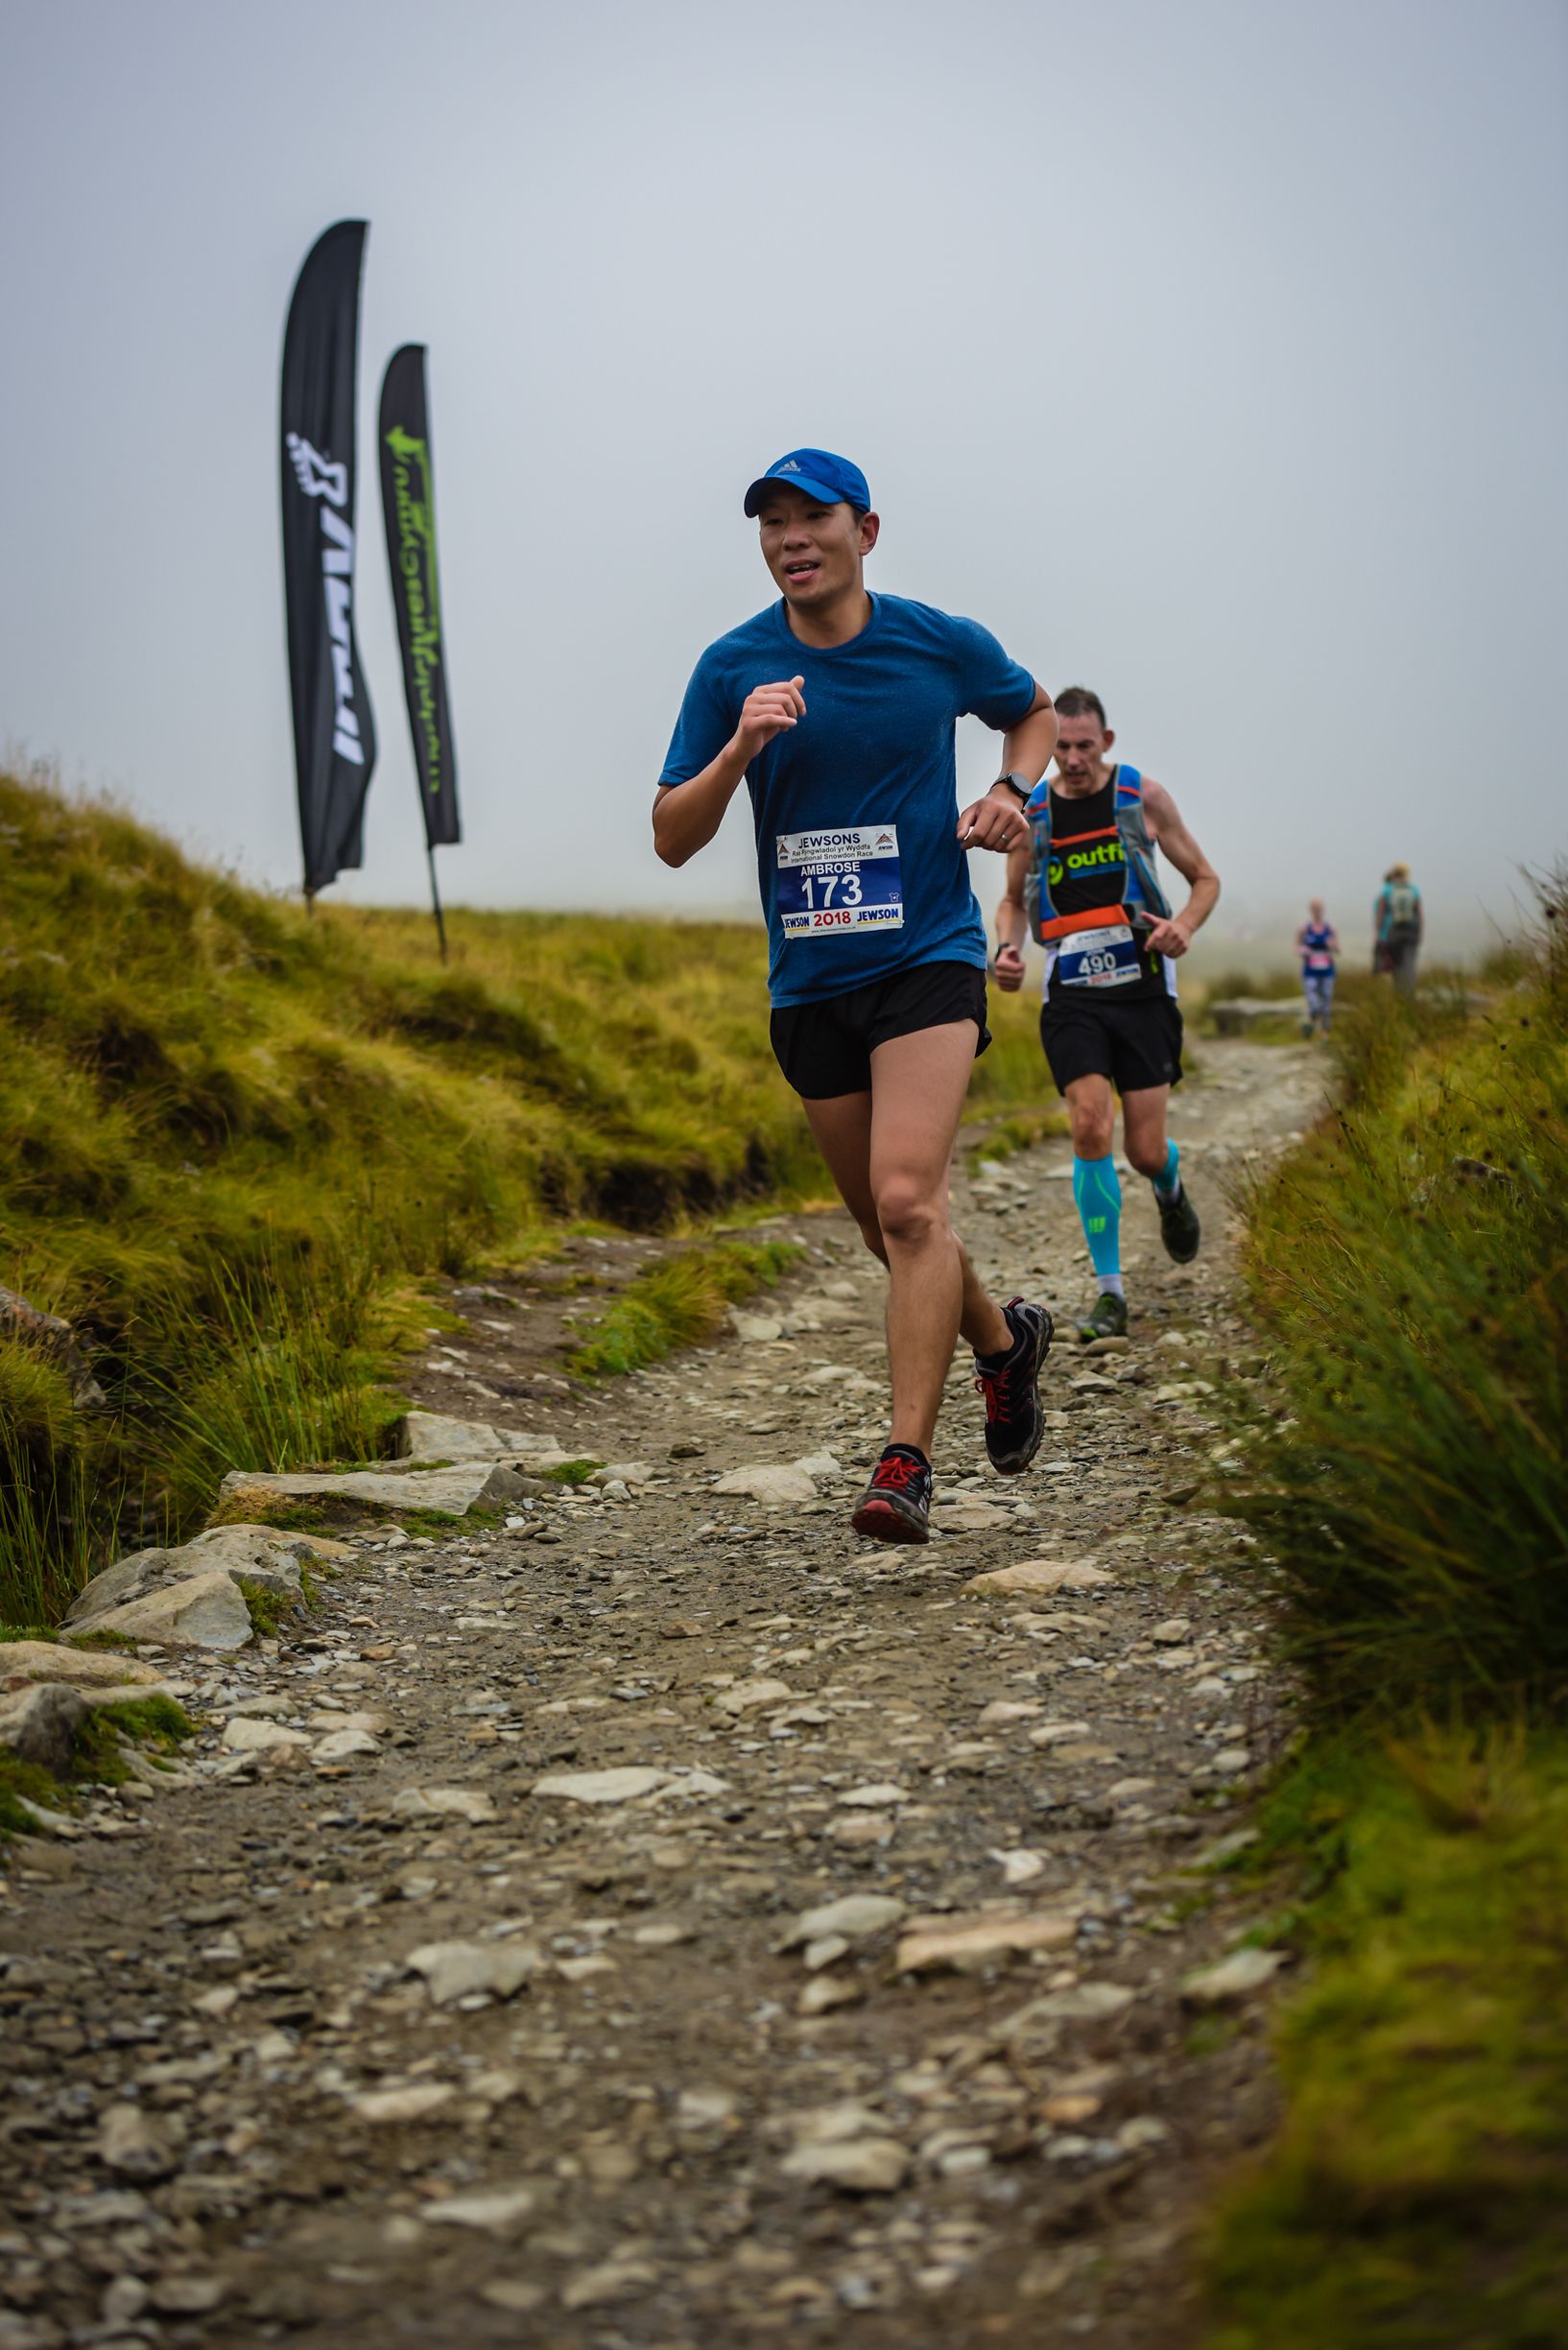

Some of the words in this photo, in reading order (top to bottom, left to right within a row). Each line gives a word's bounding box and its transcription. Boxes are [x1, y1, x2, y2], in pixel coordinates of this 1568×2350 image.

[798, 833, 861, 849] JEWSONS
[845, 843, 871, 852] Wyddfa
[823, 850, 856, 860] Snowdon
[800, 861, 861, 877] AMBROSE
[801, 874, 863, 910] 173
[784, 916, 810, 929] JEWSON
[813, 911, 851, 927] 2018
[857, 908, 899, 922] JEWSON
[1078, 952, 1117, 975] 490
